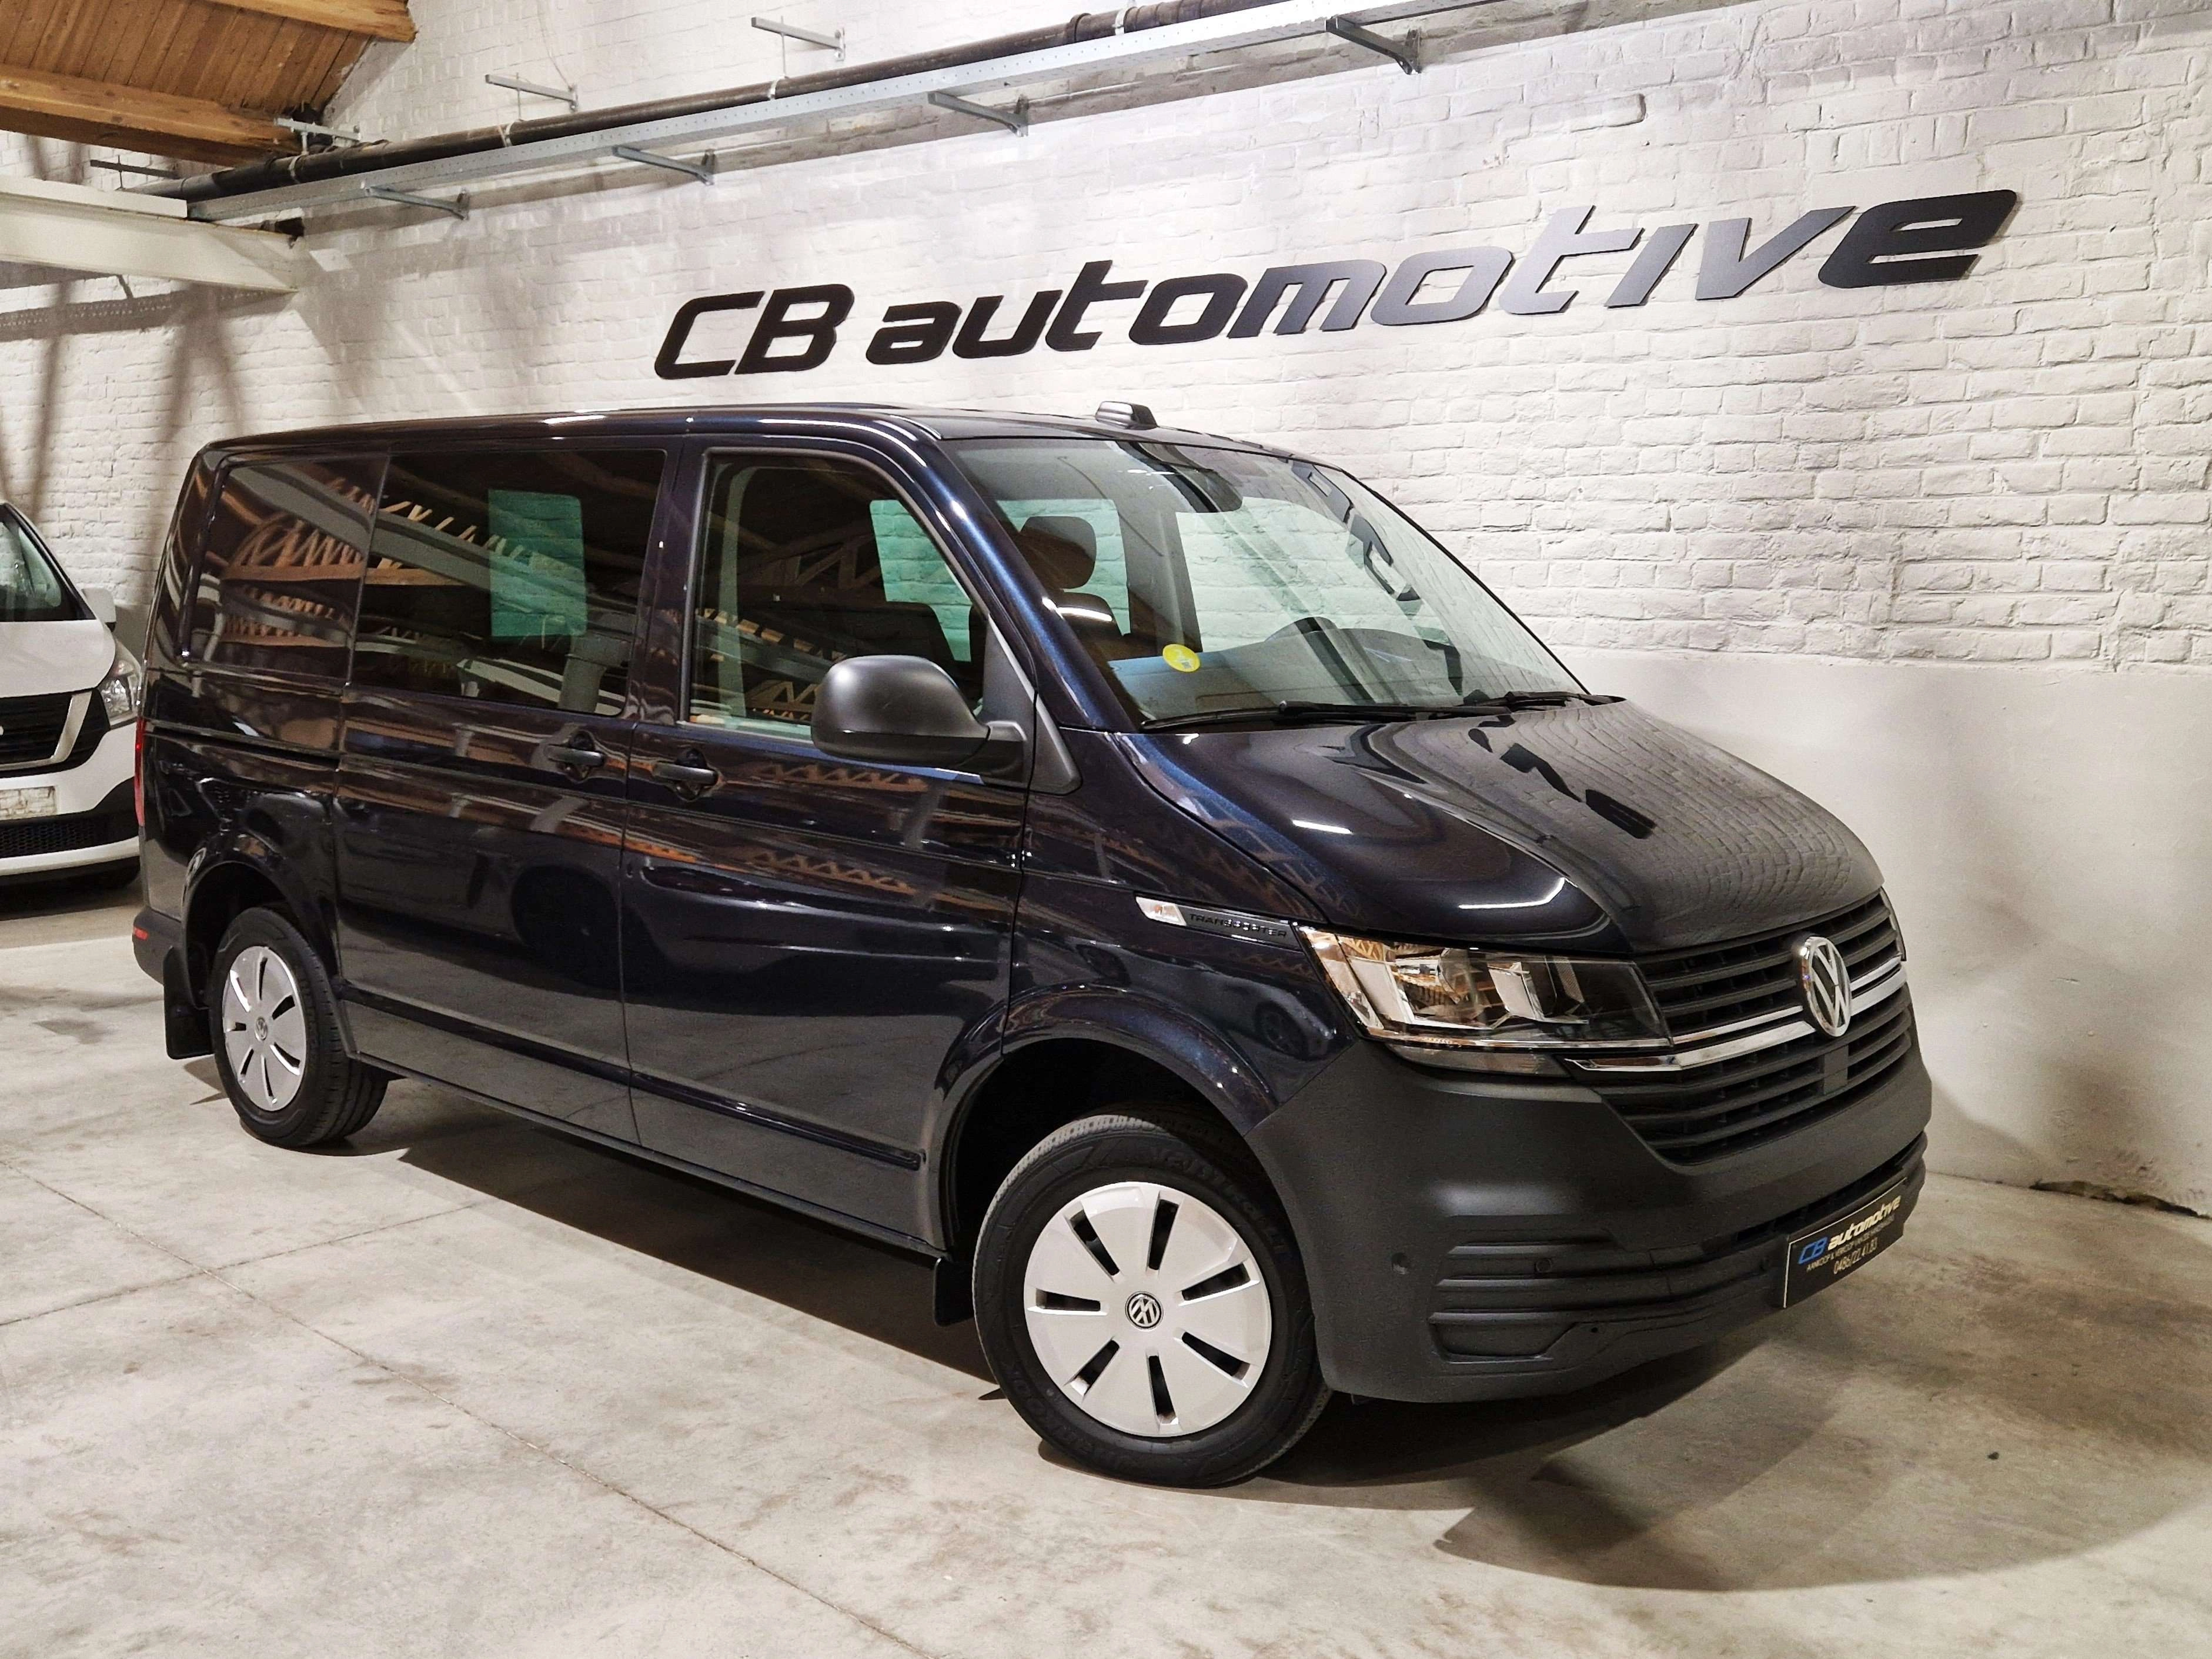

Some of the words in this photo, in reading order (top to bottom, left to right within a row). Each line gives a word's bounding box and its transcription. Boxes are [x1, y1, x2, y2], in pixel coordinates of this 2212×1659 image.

[654, 284, 854, 379] CB
[866, 189, 2017, 365] automotive
[1798, 1237, 1828, 1264] CB
[1828, 1196, 1901, 1250] automotive
